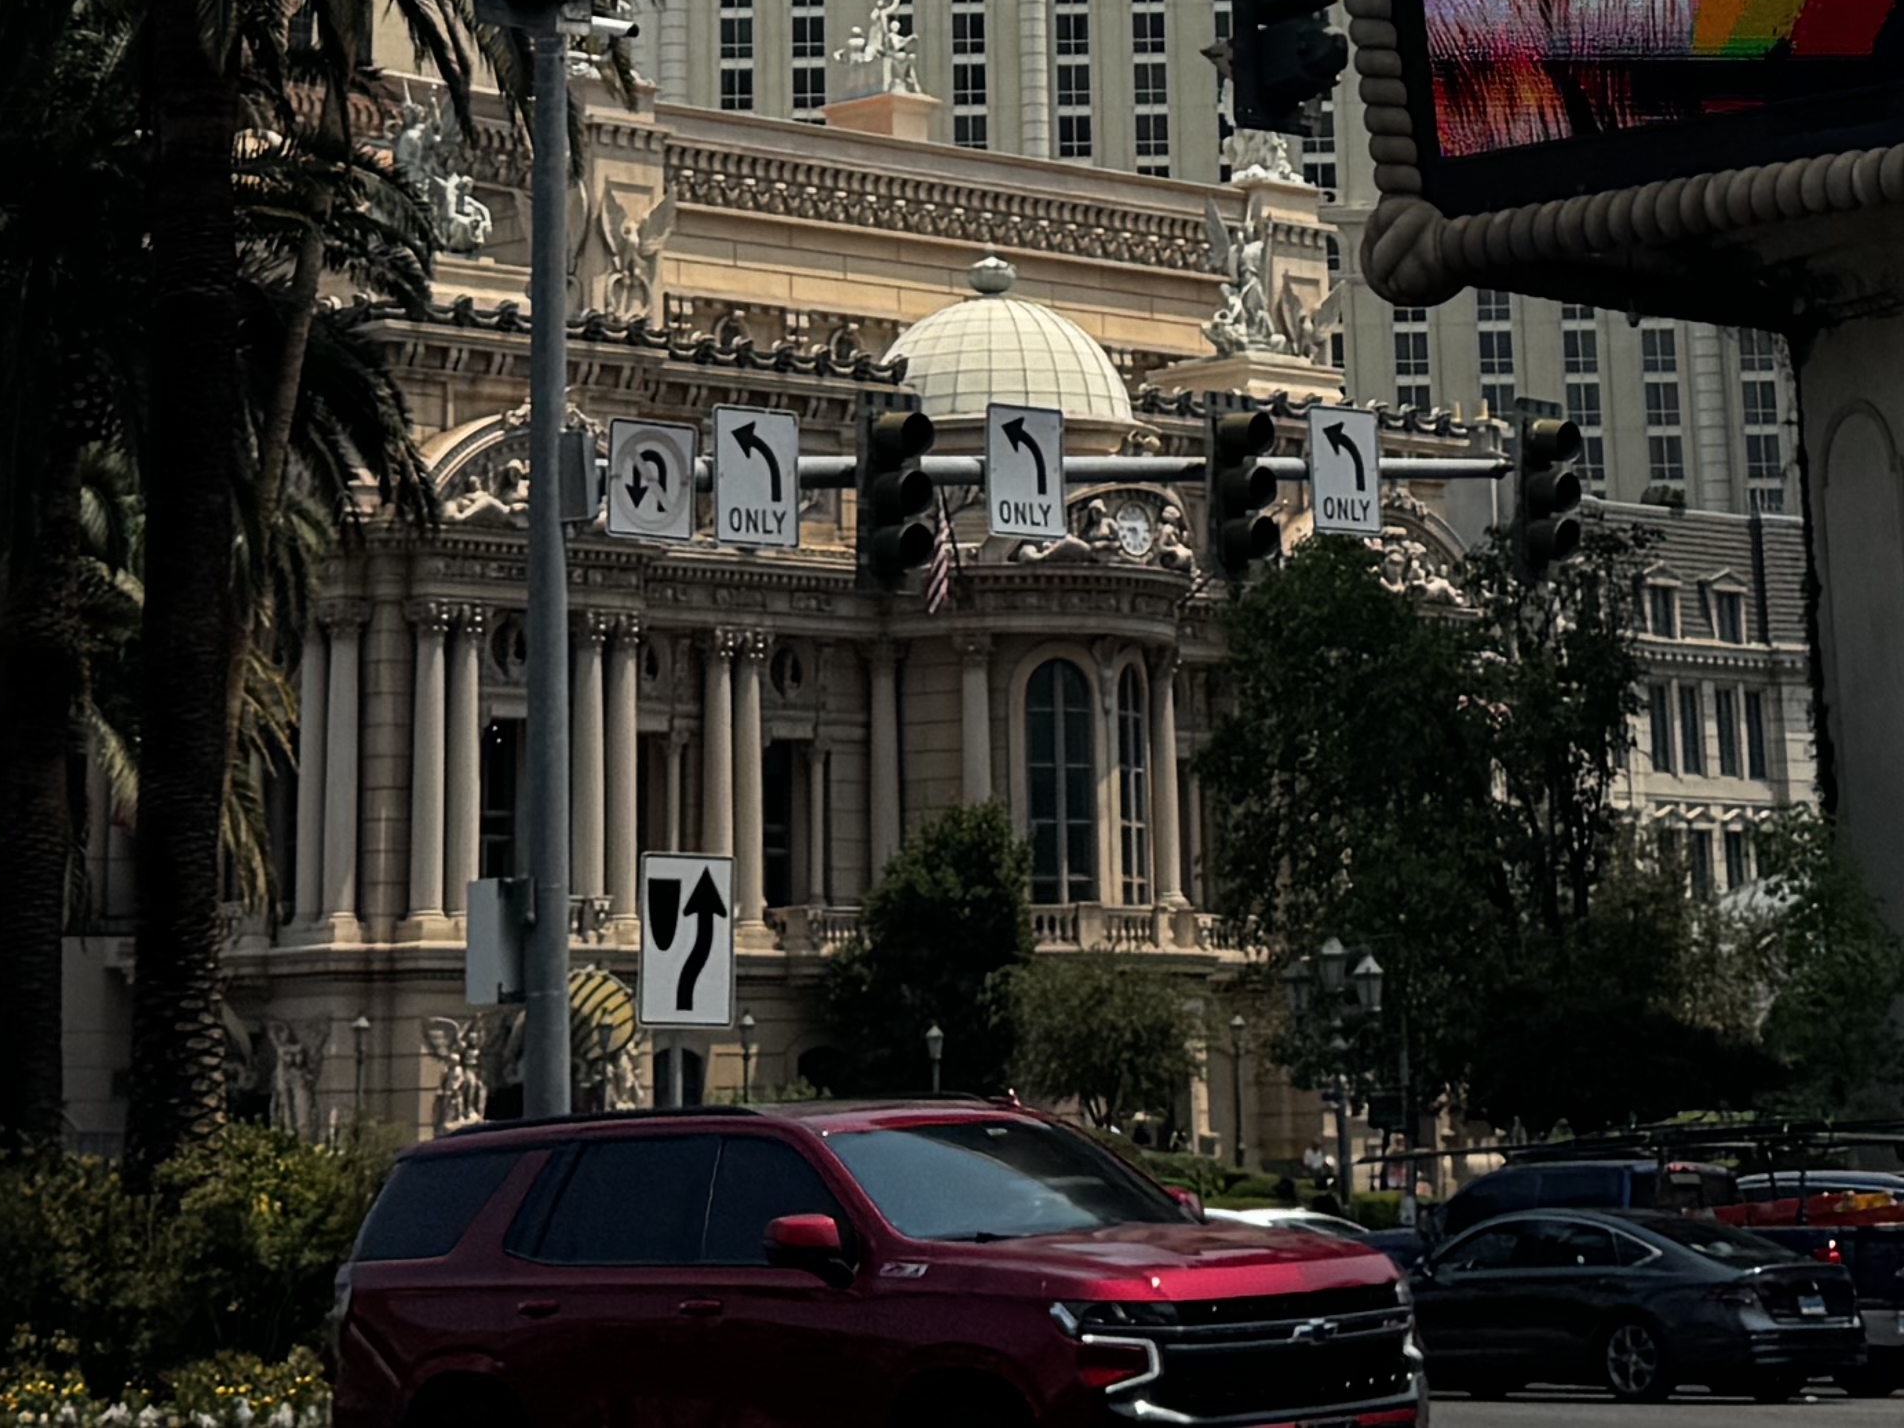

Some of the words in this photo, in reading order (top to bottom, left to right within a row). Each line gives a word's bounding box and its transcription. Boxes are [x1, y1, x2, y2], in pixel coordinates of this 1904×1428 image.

[729, 507, 786, 535] ONLY
[999, 500, 1051, 527] ONLY
[1323, 496, 1370, 522] ONLY
